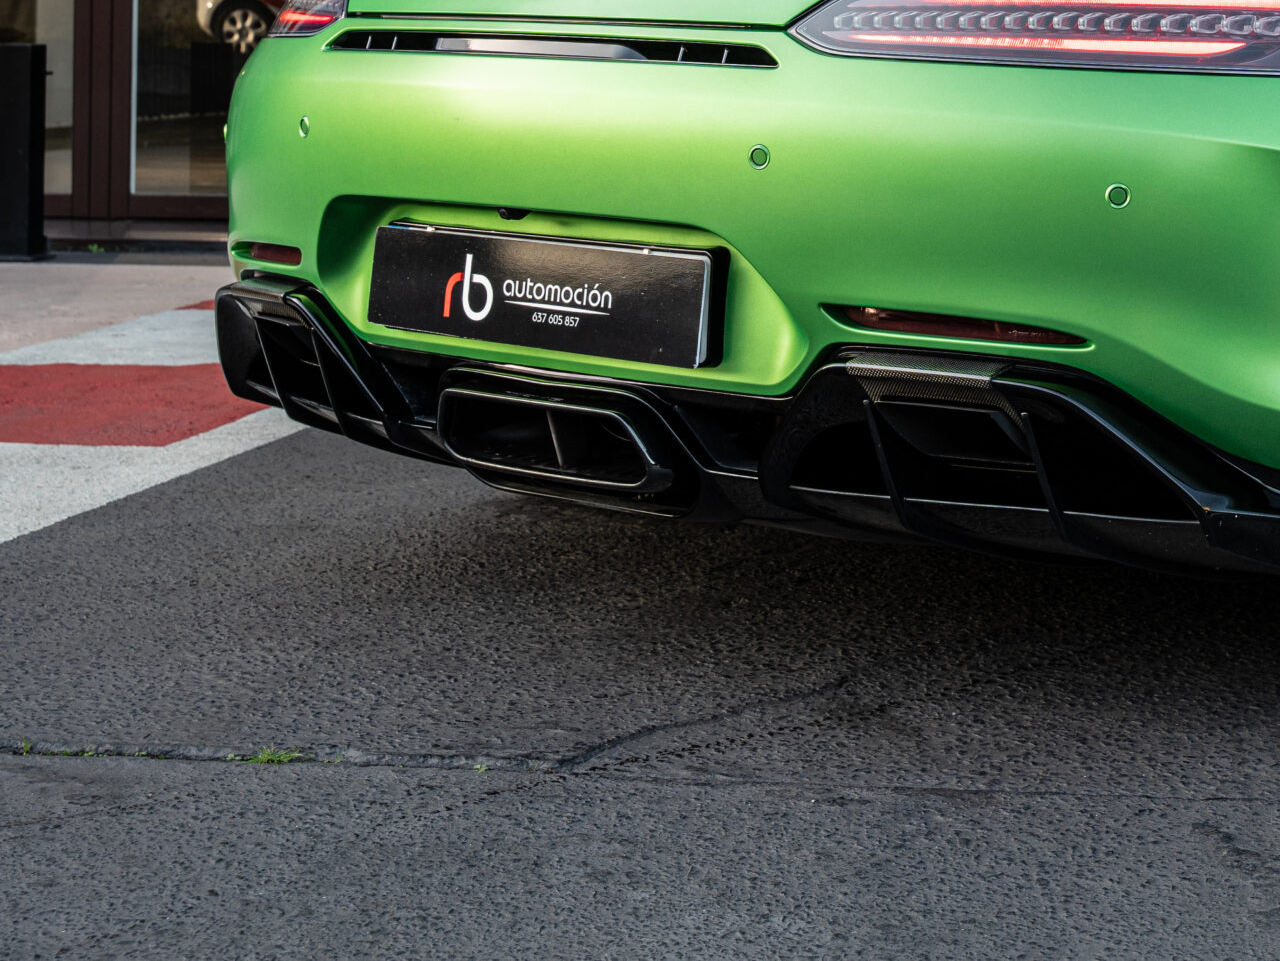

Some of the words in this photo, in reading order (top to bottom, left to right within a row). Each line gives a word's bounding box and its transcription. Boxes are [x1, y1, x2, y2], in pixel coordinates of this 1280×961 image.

[443, 253, 494, 321] rb
[502, 278, 612, 309] automoción
[532, 311, 547, 324] 637
[548, 314, 563, 326] 605
[564, 316, 580, 328] 857
